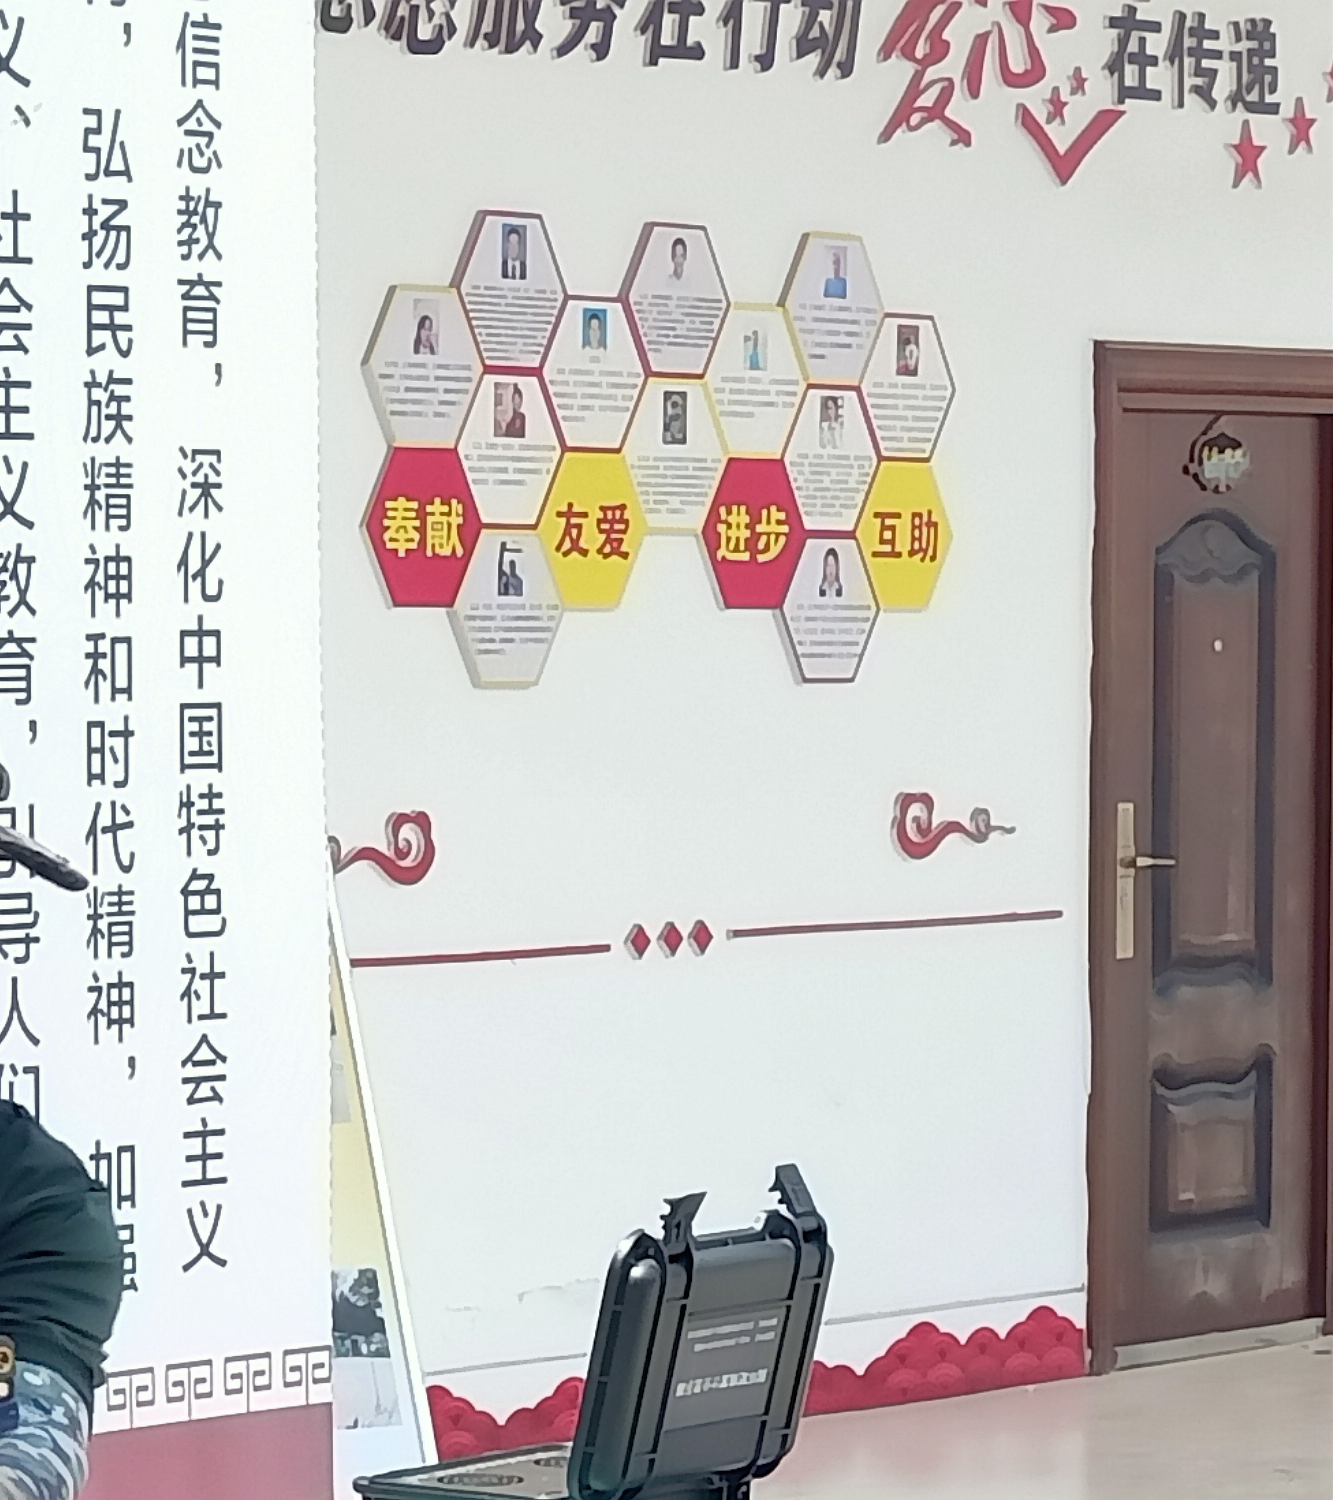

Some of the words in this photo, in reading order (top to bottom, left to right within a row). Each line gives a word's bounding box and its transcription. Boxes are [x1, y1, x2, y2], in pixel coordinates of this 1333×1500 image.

[1101, 4, 1280, 115] 在传递
[382, 496, 466, 559] 奉献
[555, 502, 632, 562] 友爱
[715, 504, 791, 563] 进步
[871, 508, 940, 563] 互助
[81, 0, 139, 1293] ，弘扬民族精神和时代精神，加
